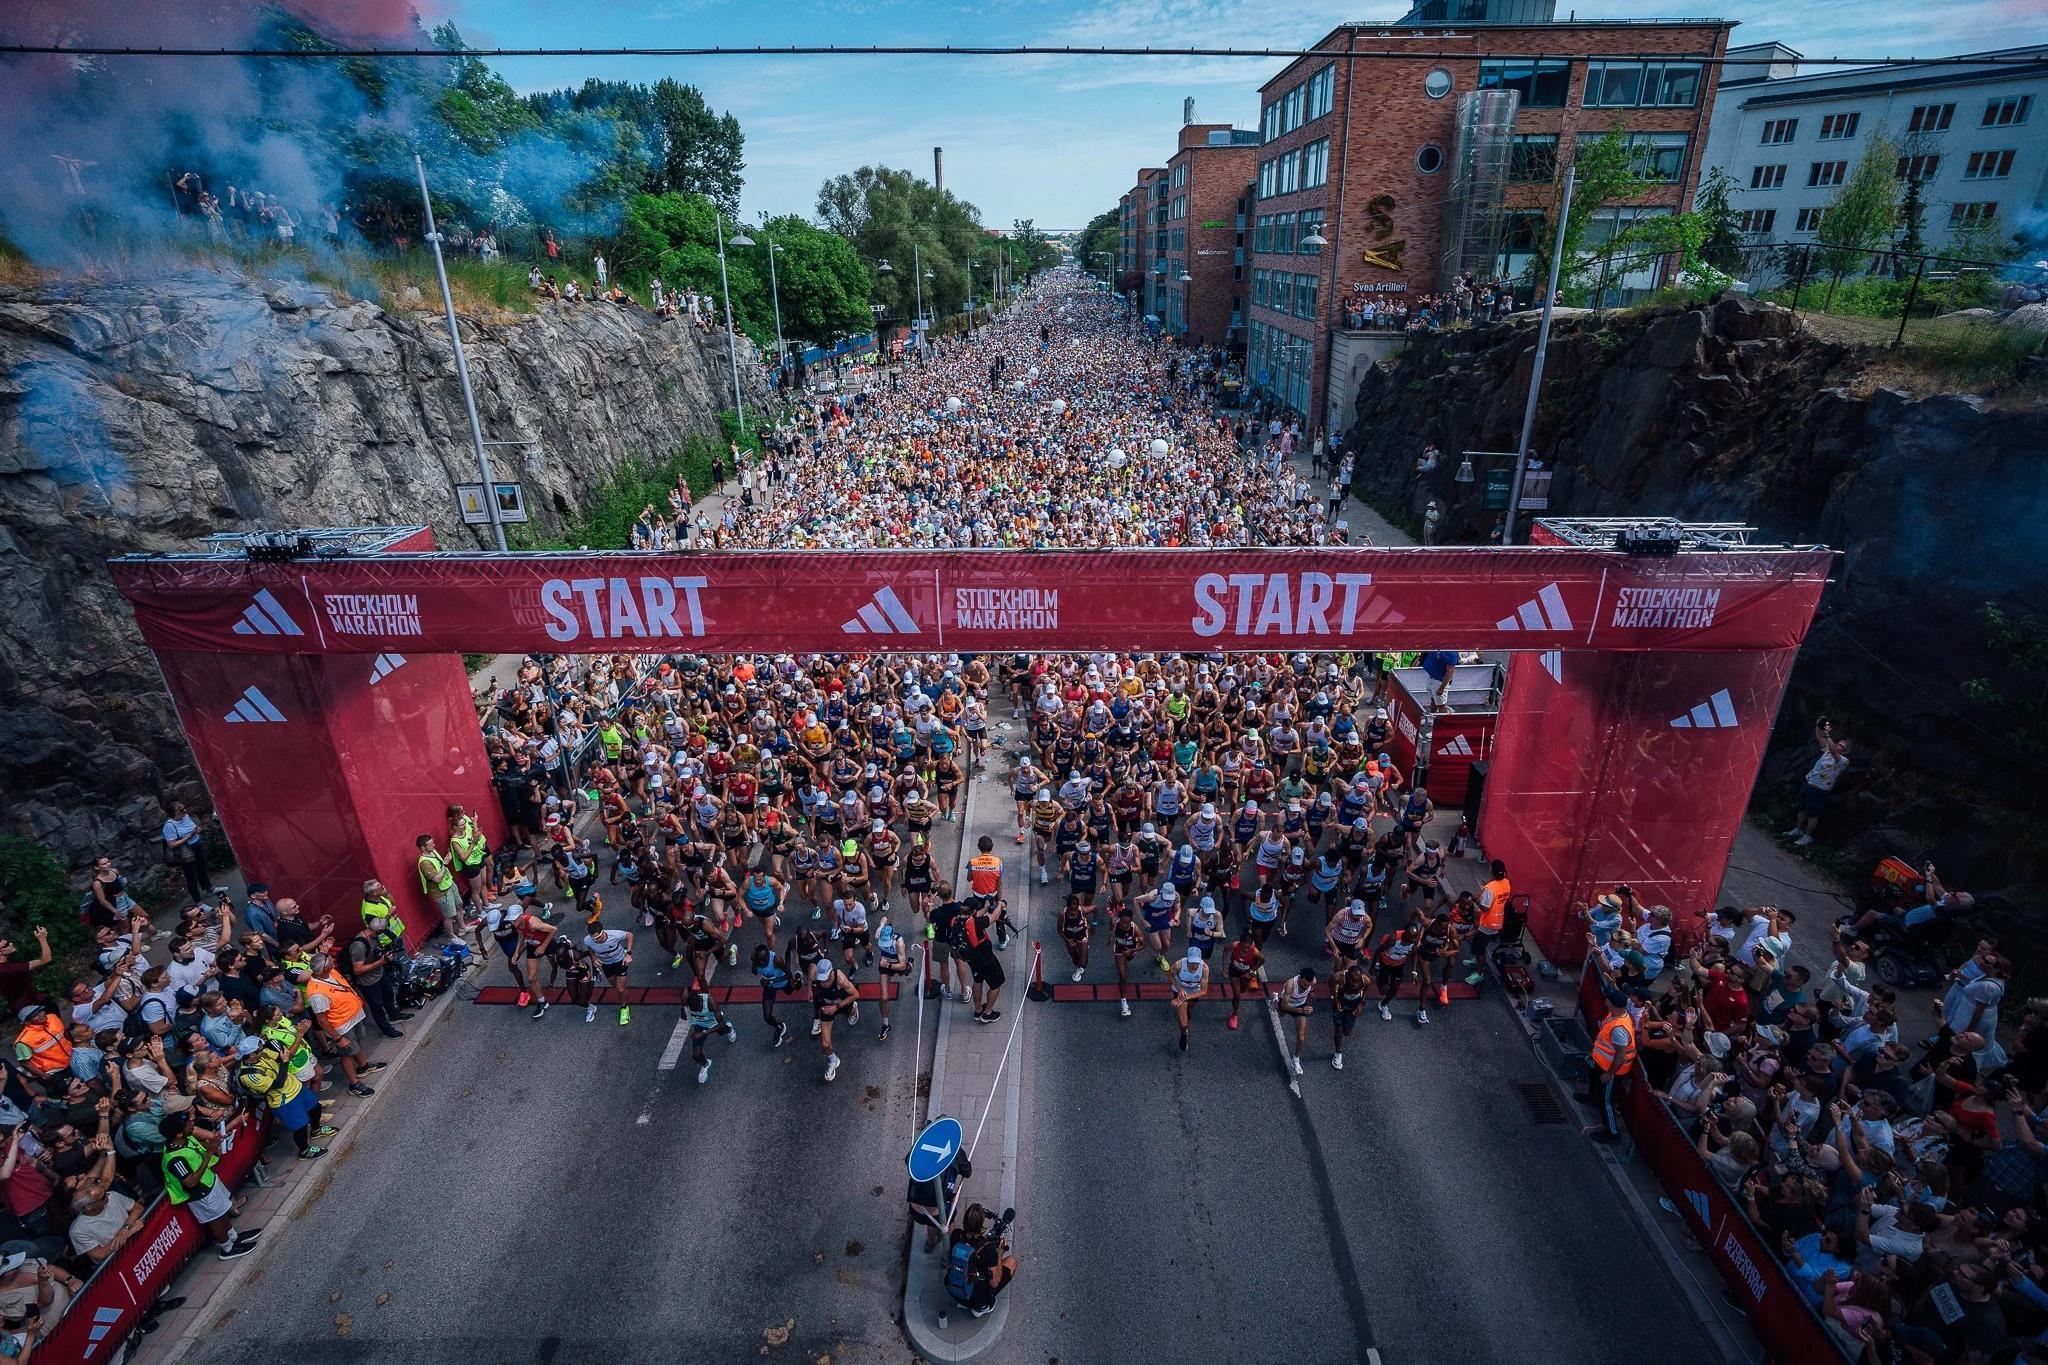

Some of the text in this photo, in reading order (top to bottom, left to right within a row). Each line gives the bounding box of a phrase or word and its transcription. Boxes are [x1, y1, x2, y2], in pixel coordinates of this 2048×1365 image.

[1354, 283, 1407, 292] Svea Artilleri
[324, 594, 419, 616] STOCKHOLM
[540, 576, 708, 642] START
[956, 588, 1058, 610] STOCKHOLM
[1191, 572, 1372, 637] START
[1616, 588, 1721, 609] STOCKHOLM
[329, 615, 422, 636] MARATHON
[957, 610, 1058, 629] MARATHON
[1611, 608, 1716, 628] MARATHON
[133, 1216, 179, 1276] STOCKHOLM
[137, 1224, 183, 1286] MARATHON
